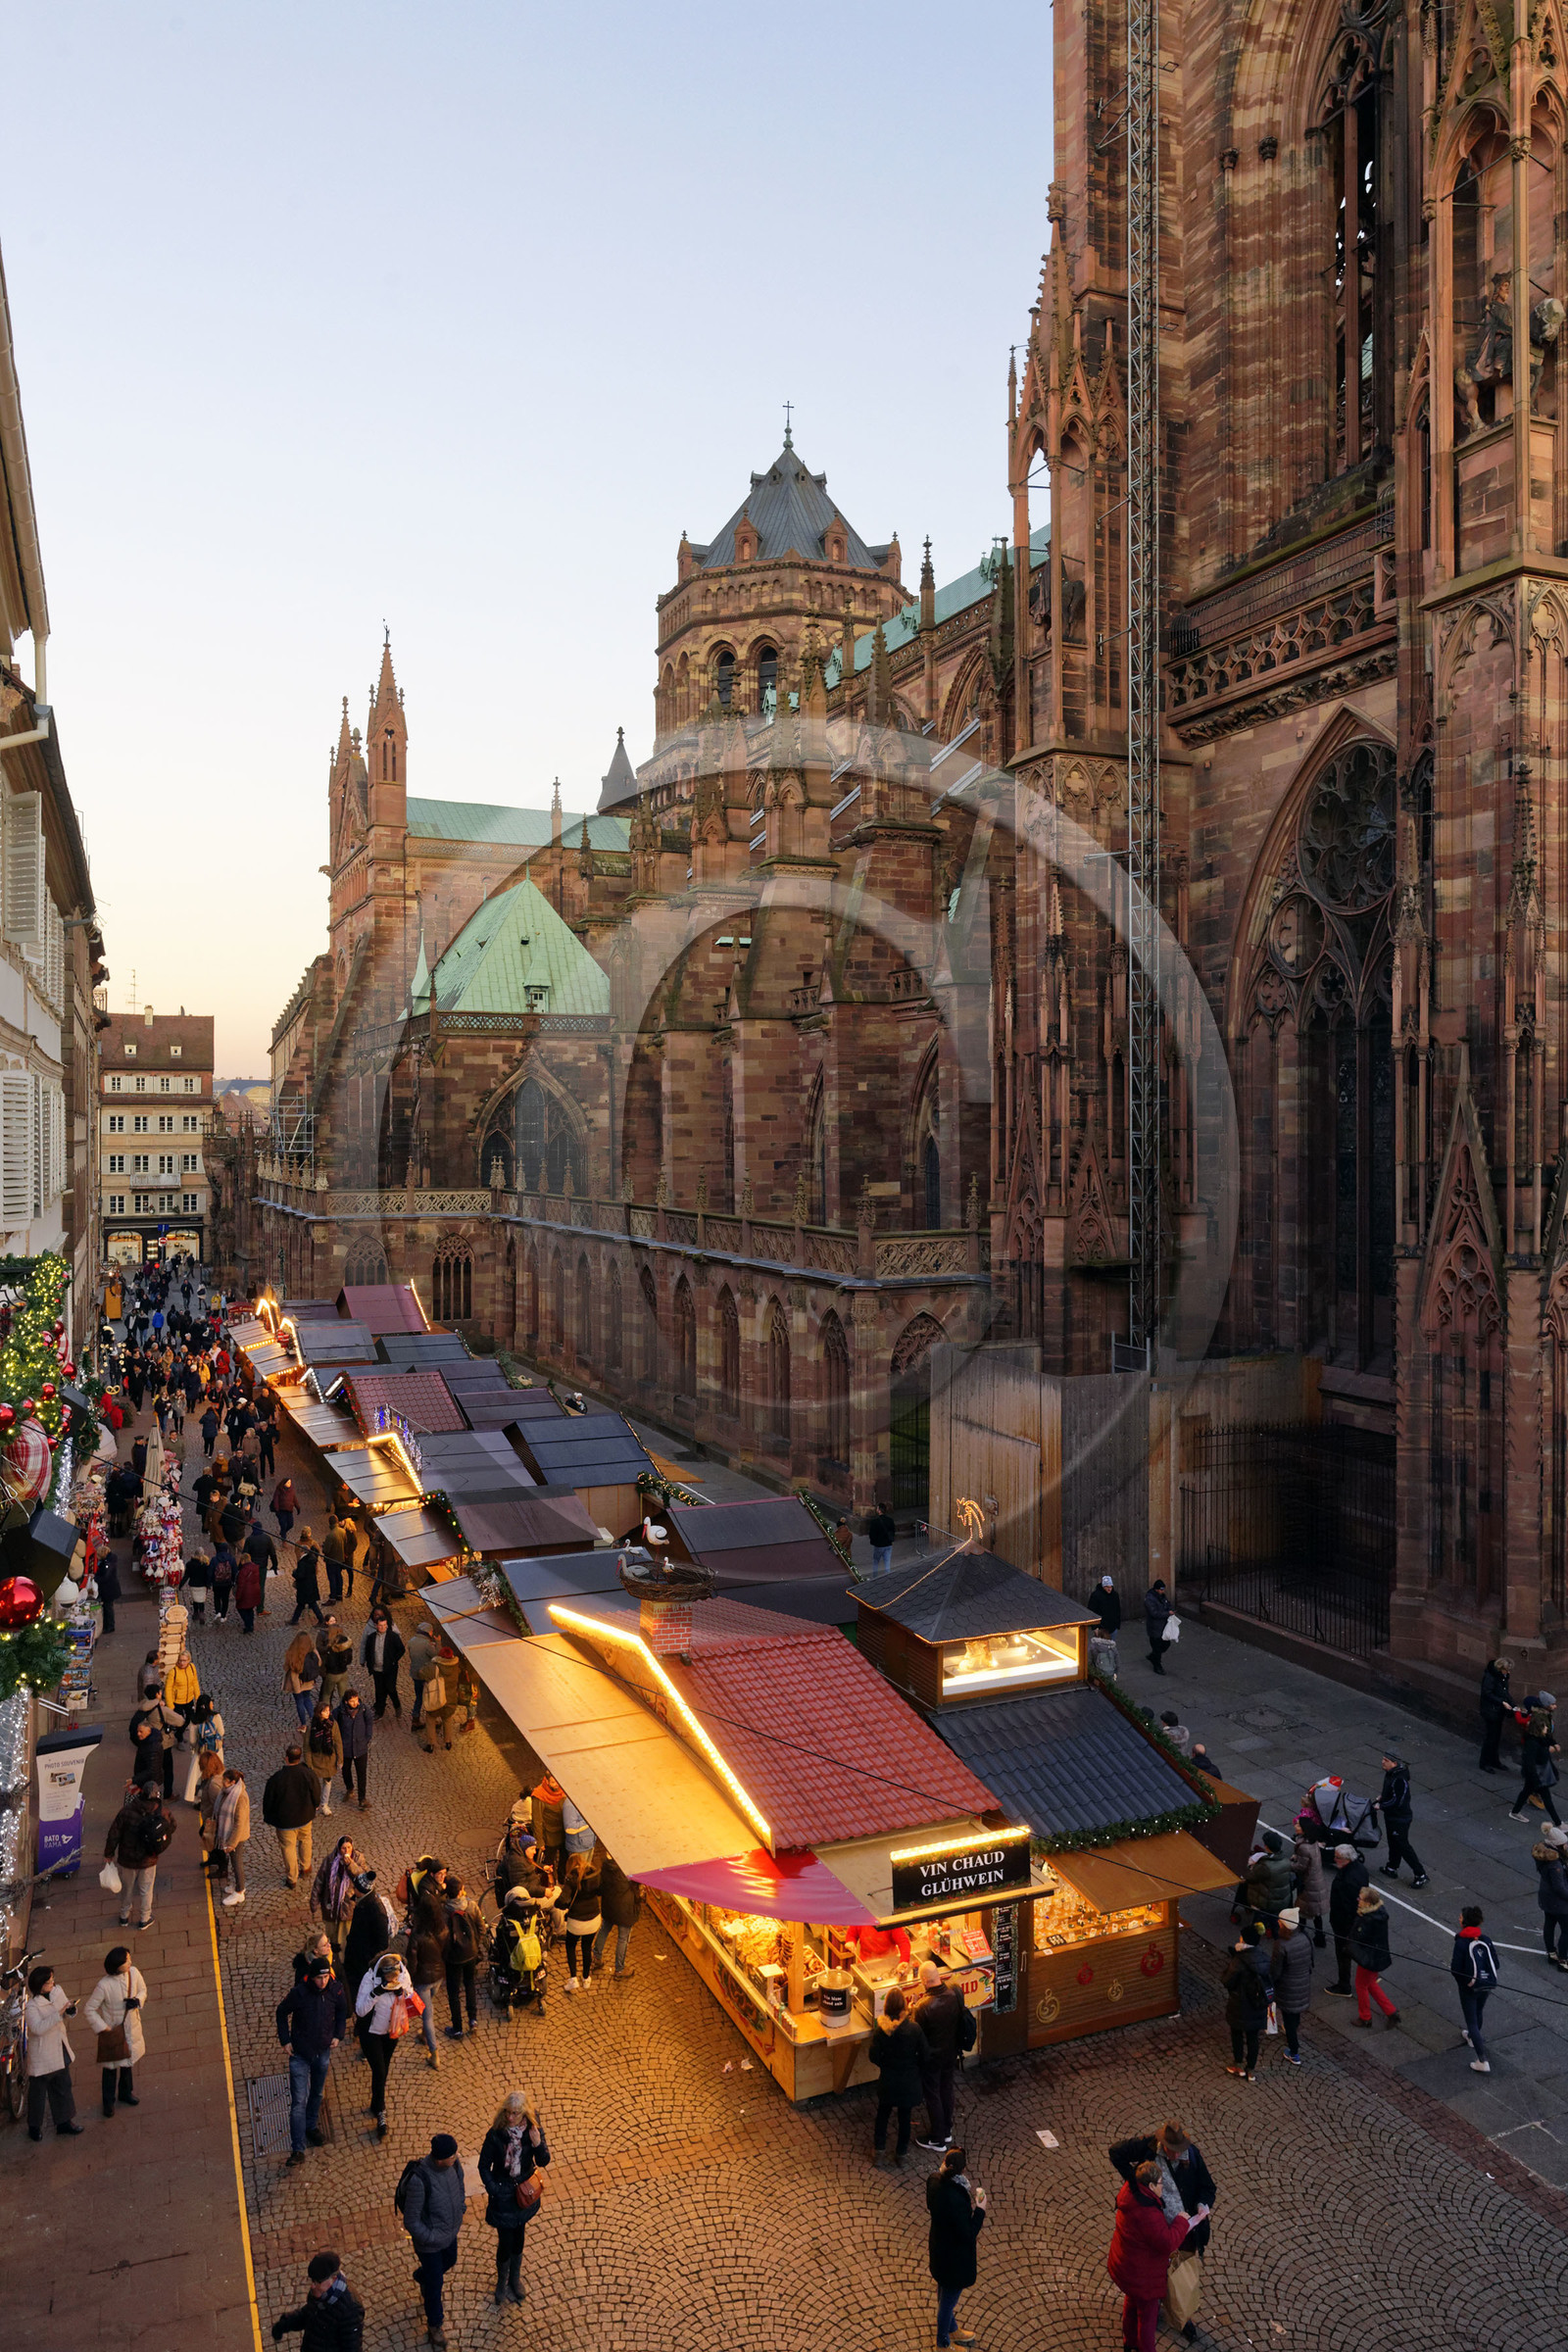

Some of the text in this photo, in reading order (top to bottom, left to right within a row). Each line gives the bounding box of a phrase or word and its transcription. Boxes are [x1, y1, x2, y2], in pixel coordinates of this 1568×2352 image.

[61, 1758, 84, 1767] SOUVENIR
[44, 1835, 60, 1843] BATO
[44, 1840, 62, 1849] RAMA
[919, 1850, 1005, 1878] VIN CHAUD
[920, 1869, 1004, 1896] GLÜHWEIN
